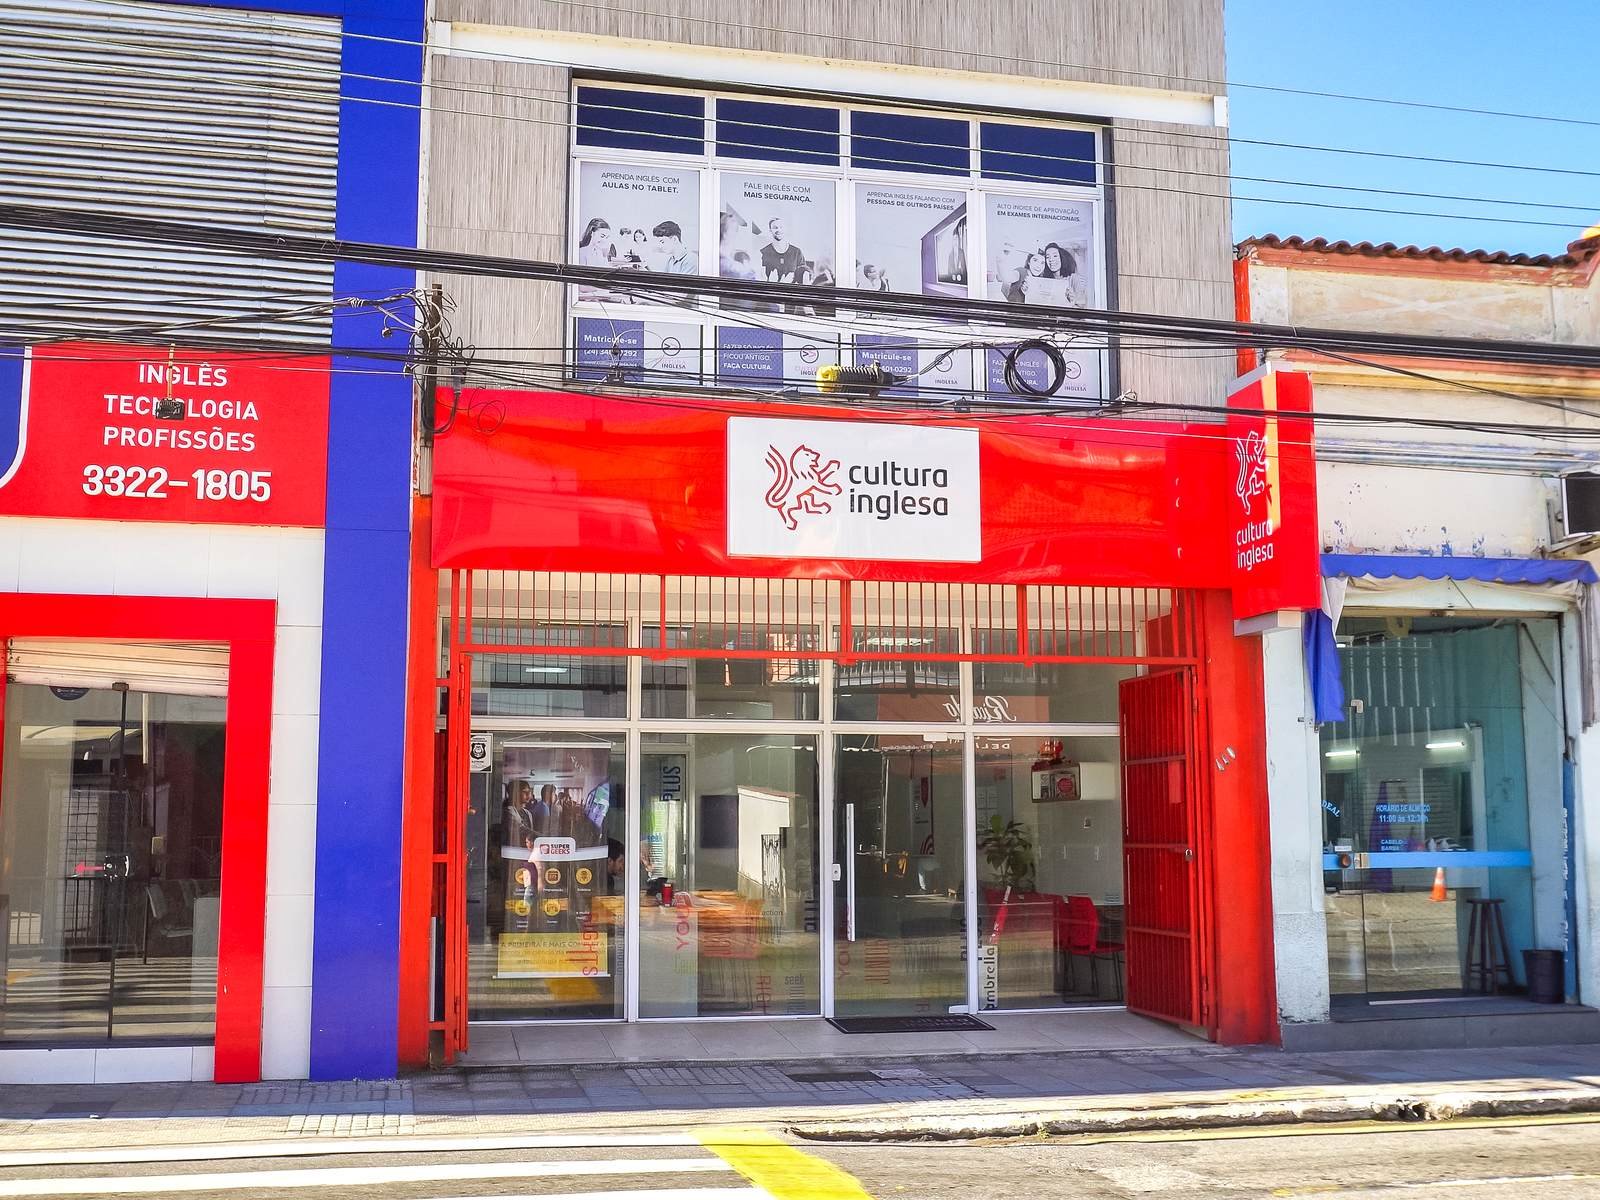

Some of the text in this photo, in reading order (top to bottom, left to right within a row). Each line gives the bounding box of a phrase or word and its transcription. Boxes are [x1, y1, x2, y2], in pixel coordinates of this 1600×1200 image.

[601, 172, 634, 181] APRENDA
[662, 176, 680, 184] COM
[602, 181, 629, 190] AULAS
[647, 184, 679, 194] TABLET.
[743, 182, 811, 193] FALE INGLÊS COM
[743, 191, 763, 199] MAIS
[866, 191, 893, 199] APRENDA
[914, 194, 941, 202] FALANDO
[906, 201, 932, 209] OUTROS
[1007, 211, 1031, 219] EXAMES
[861, 351, 912, 360] Matricule-se
[139, 362, 228, 388] INGLÊS
[103, 394, 260, 422] TECLOGIA
[103, 426, 256, 452] PROFISSÕES
[82, 464, 272, 502] 3322-1805
[849, 461, 949, 488] cultura
[849, 488, 949, 520] inglesa
[1236, 519, 1273, 546] cultura
[1237, 542, 1274, 571] inglesa
[662, 765, 682, 802] PLUS
